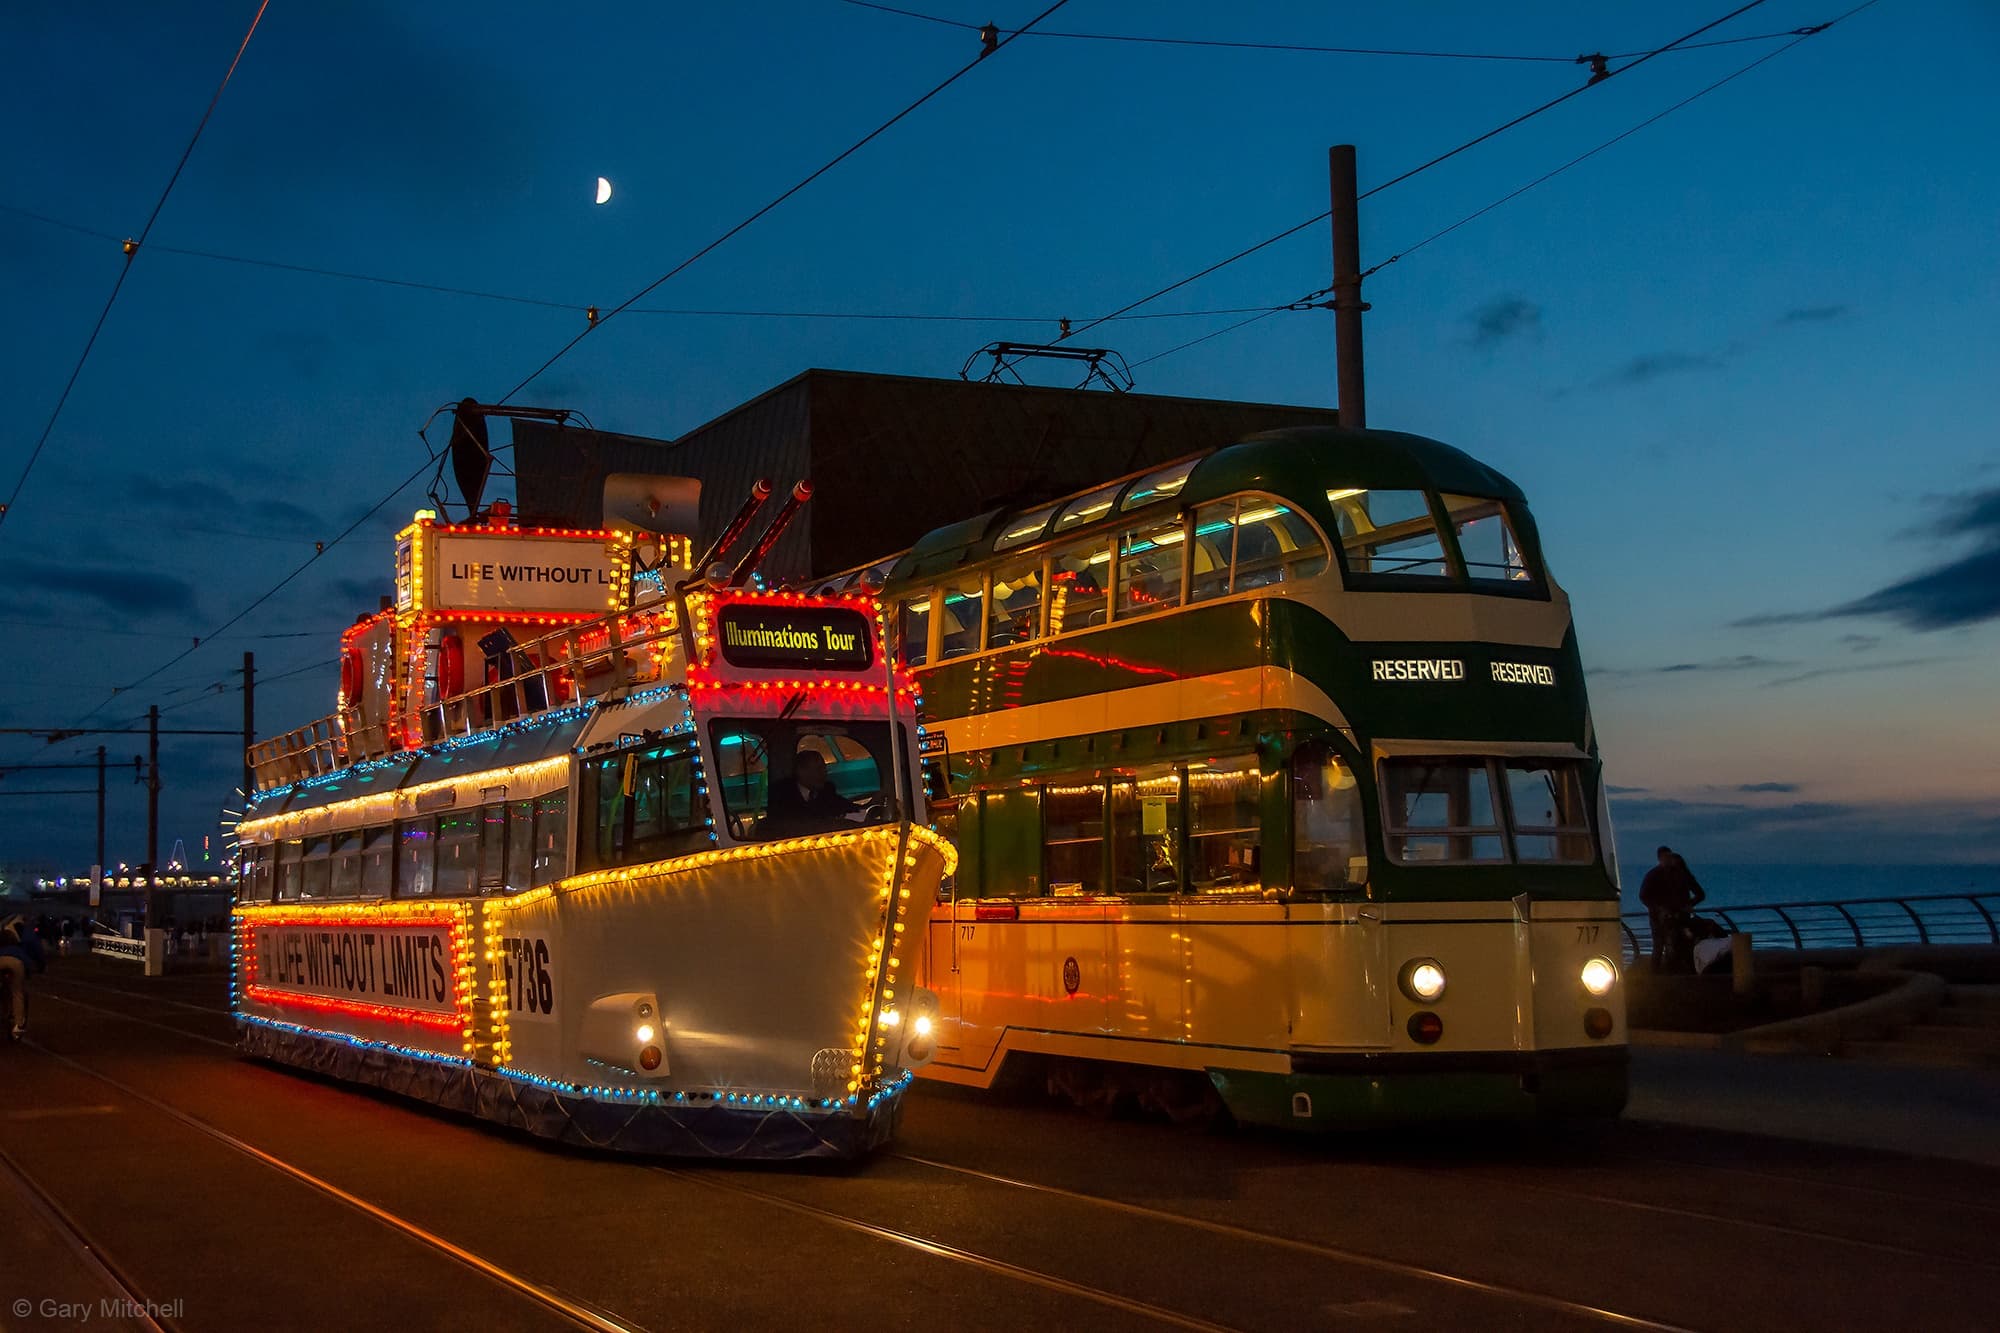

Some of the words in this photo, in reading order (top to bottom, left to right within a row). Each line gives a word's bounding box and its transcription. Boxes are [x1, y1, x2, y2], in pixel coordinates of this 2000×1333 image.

[453, 564, 493, 580] LIFE
[500, 566, 592, 583] WITHOUT
[725, 621, 818, 649] Illuminations
[823, 625, 855, 651] Tour
[1372, 659, 1464, 680] RESERVED
[1490, 661, 1554, 685] RESERVED
[961, 926, 975, 940] 717
[1576, 926, 1599, 944] 717
[276, 934, 304, 984] LIFE
[305, 933, 375, 992] WITHOUT
[381, 935, 445, 1003] LIMITS
[503, 938, 553, 1014] F736
